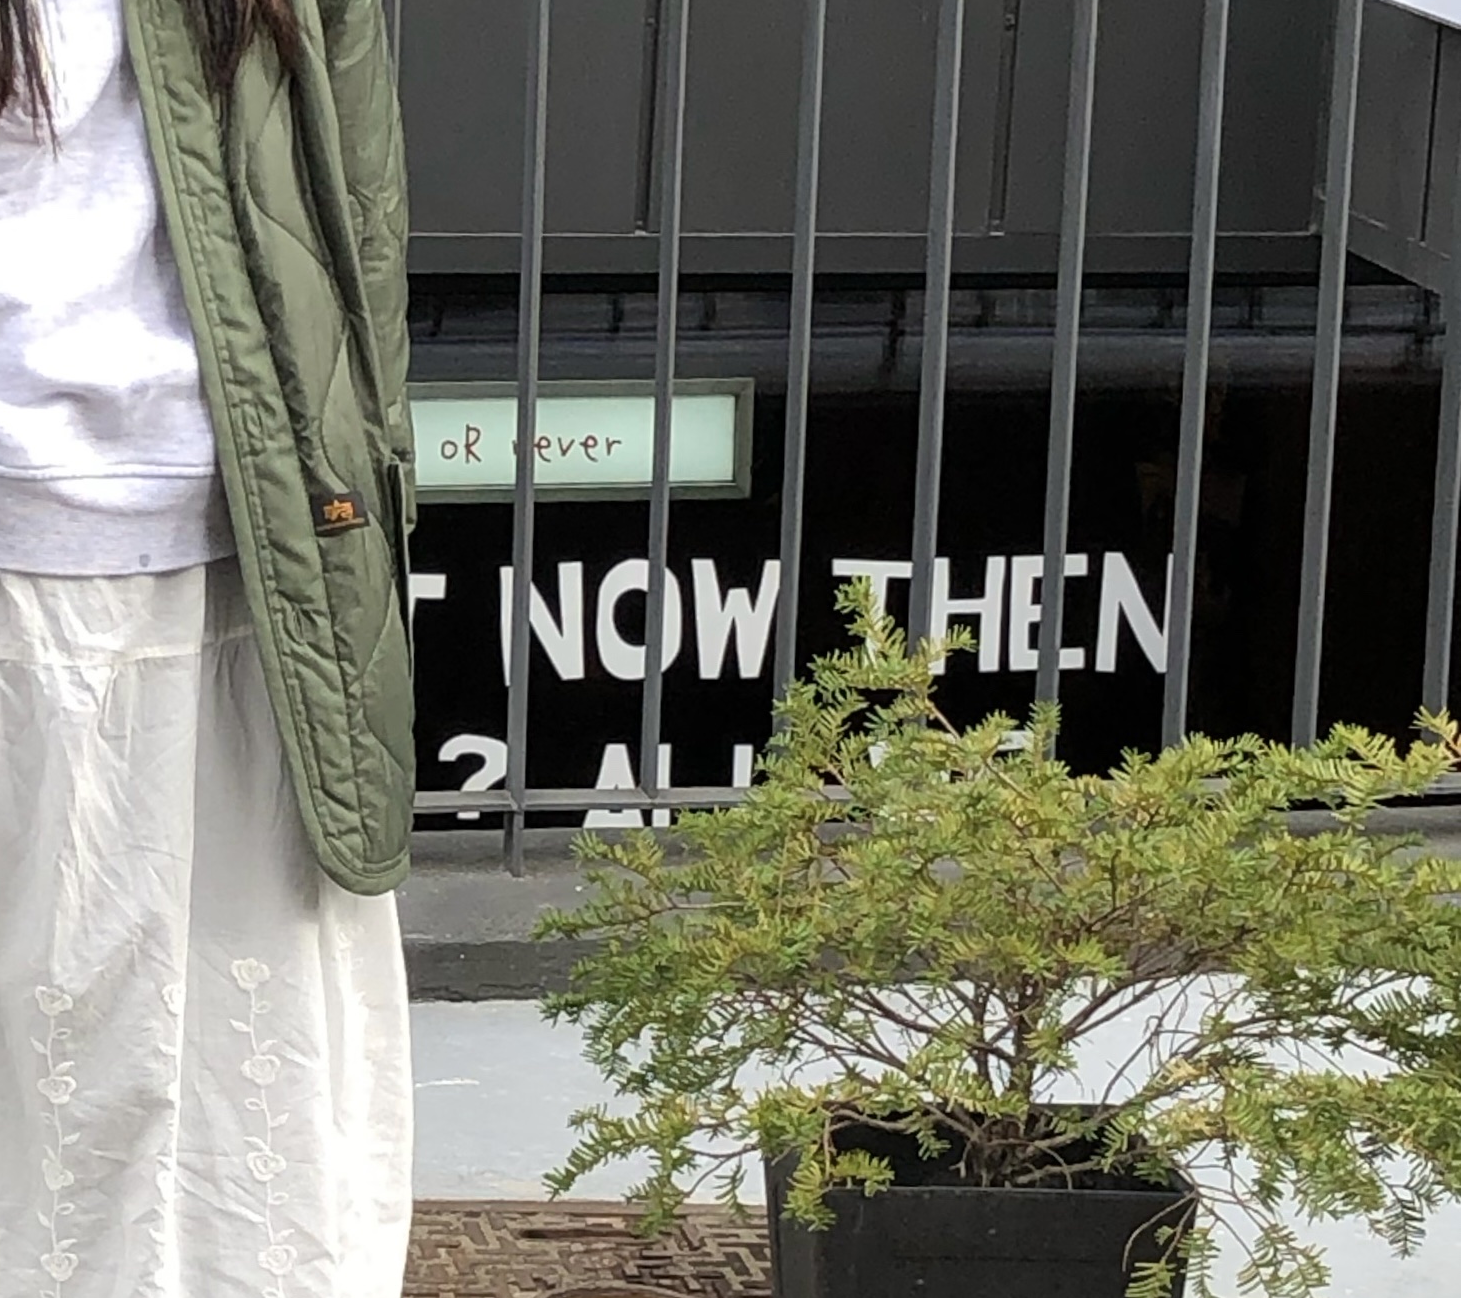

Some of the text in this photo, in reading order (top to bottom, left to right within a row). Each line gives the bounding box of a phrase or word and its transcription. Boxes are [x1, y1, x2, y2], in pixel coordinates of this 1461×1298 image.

[441, 424, 482, 464] oR
[499, 559, 781, 687] NOW
[832, 552, 1173, 675] THEN
